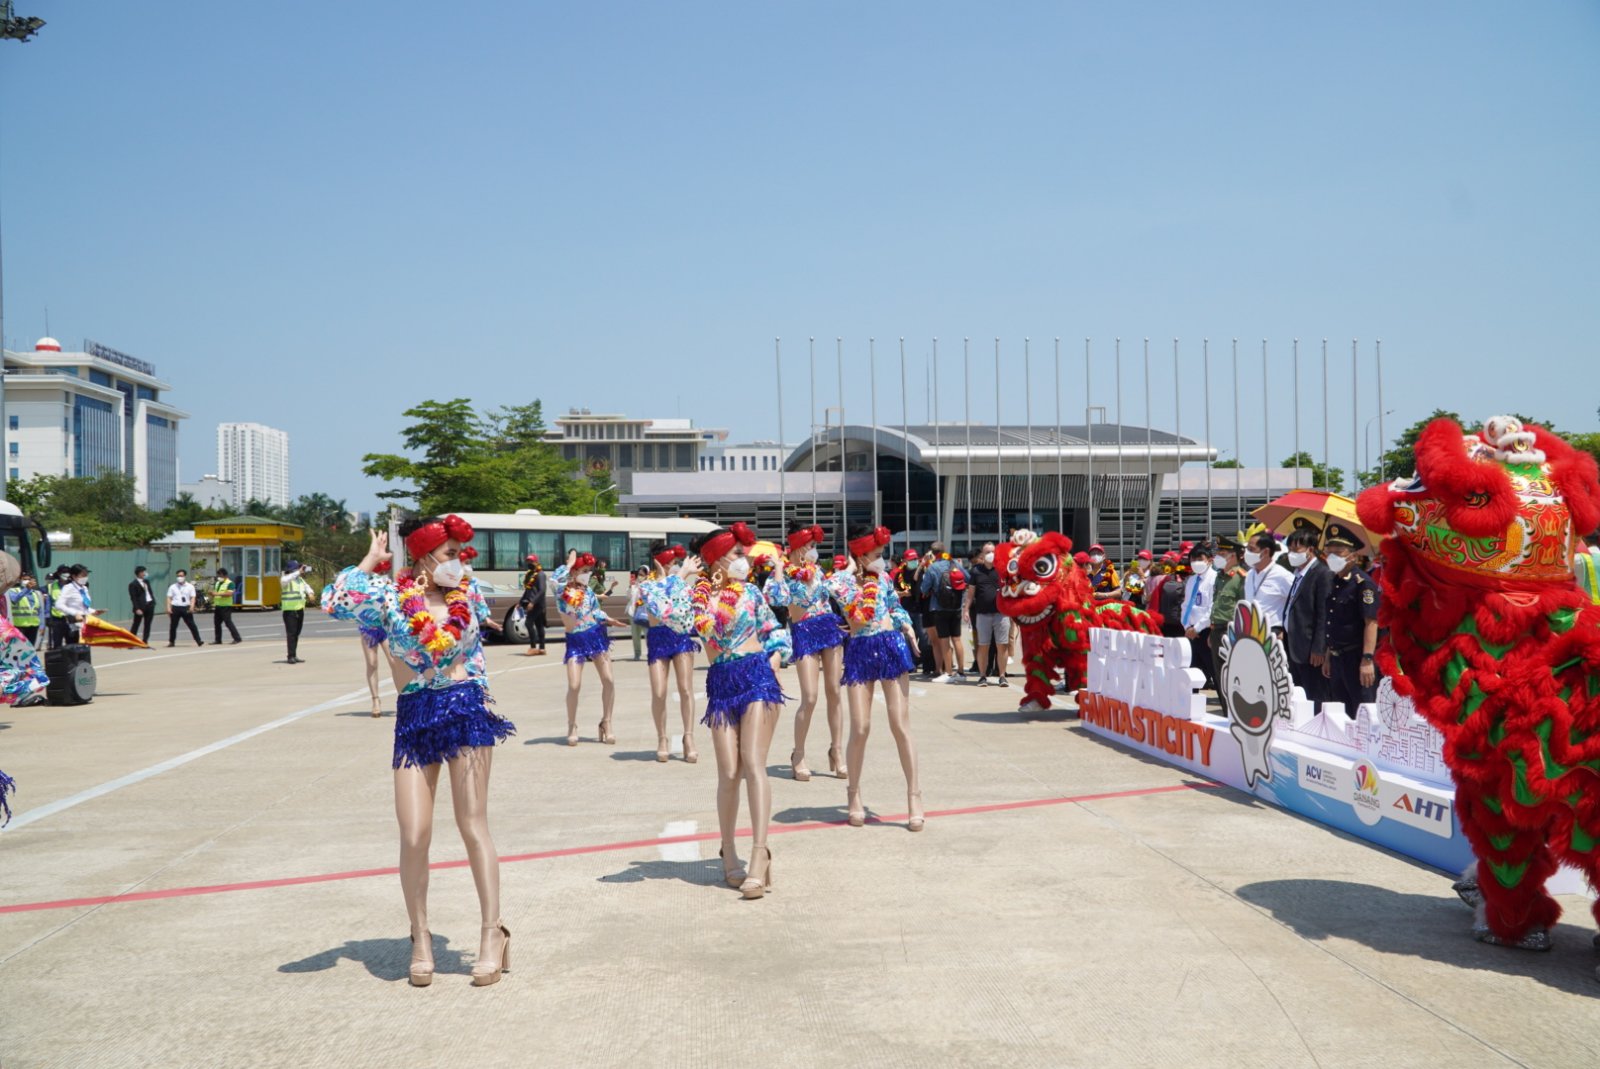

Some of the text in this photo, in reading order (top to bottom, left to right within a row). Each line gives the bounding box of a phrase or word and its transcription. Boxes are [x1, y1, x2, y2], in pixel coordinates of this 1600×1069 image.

[1269, 644, 1291, 719] Hello!
[1079, 689, 1215, 766] FANTASTICITY
[1305, 765, 1322, 780] ACV
[1392, 793, 1449, 822] AHT
